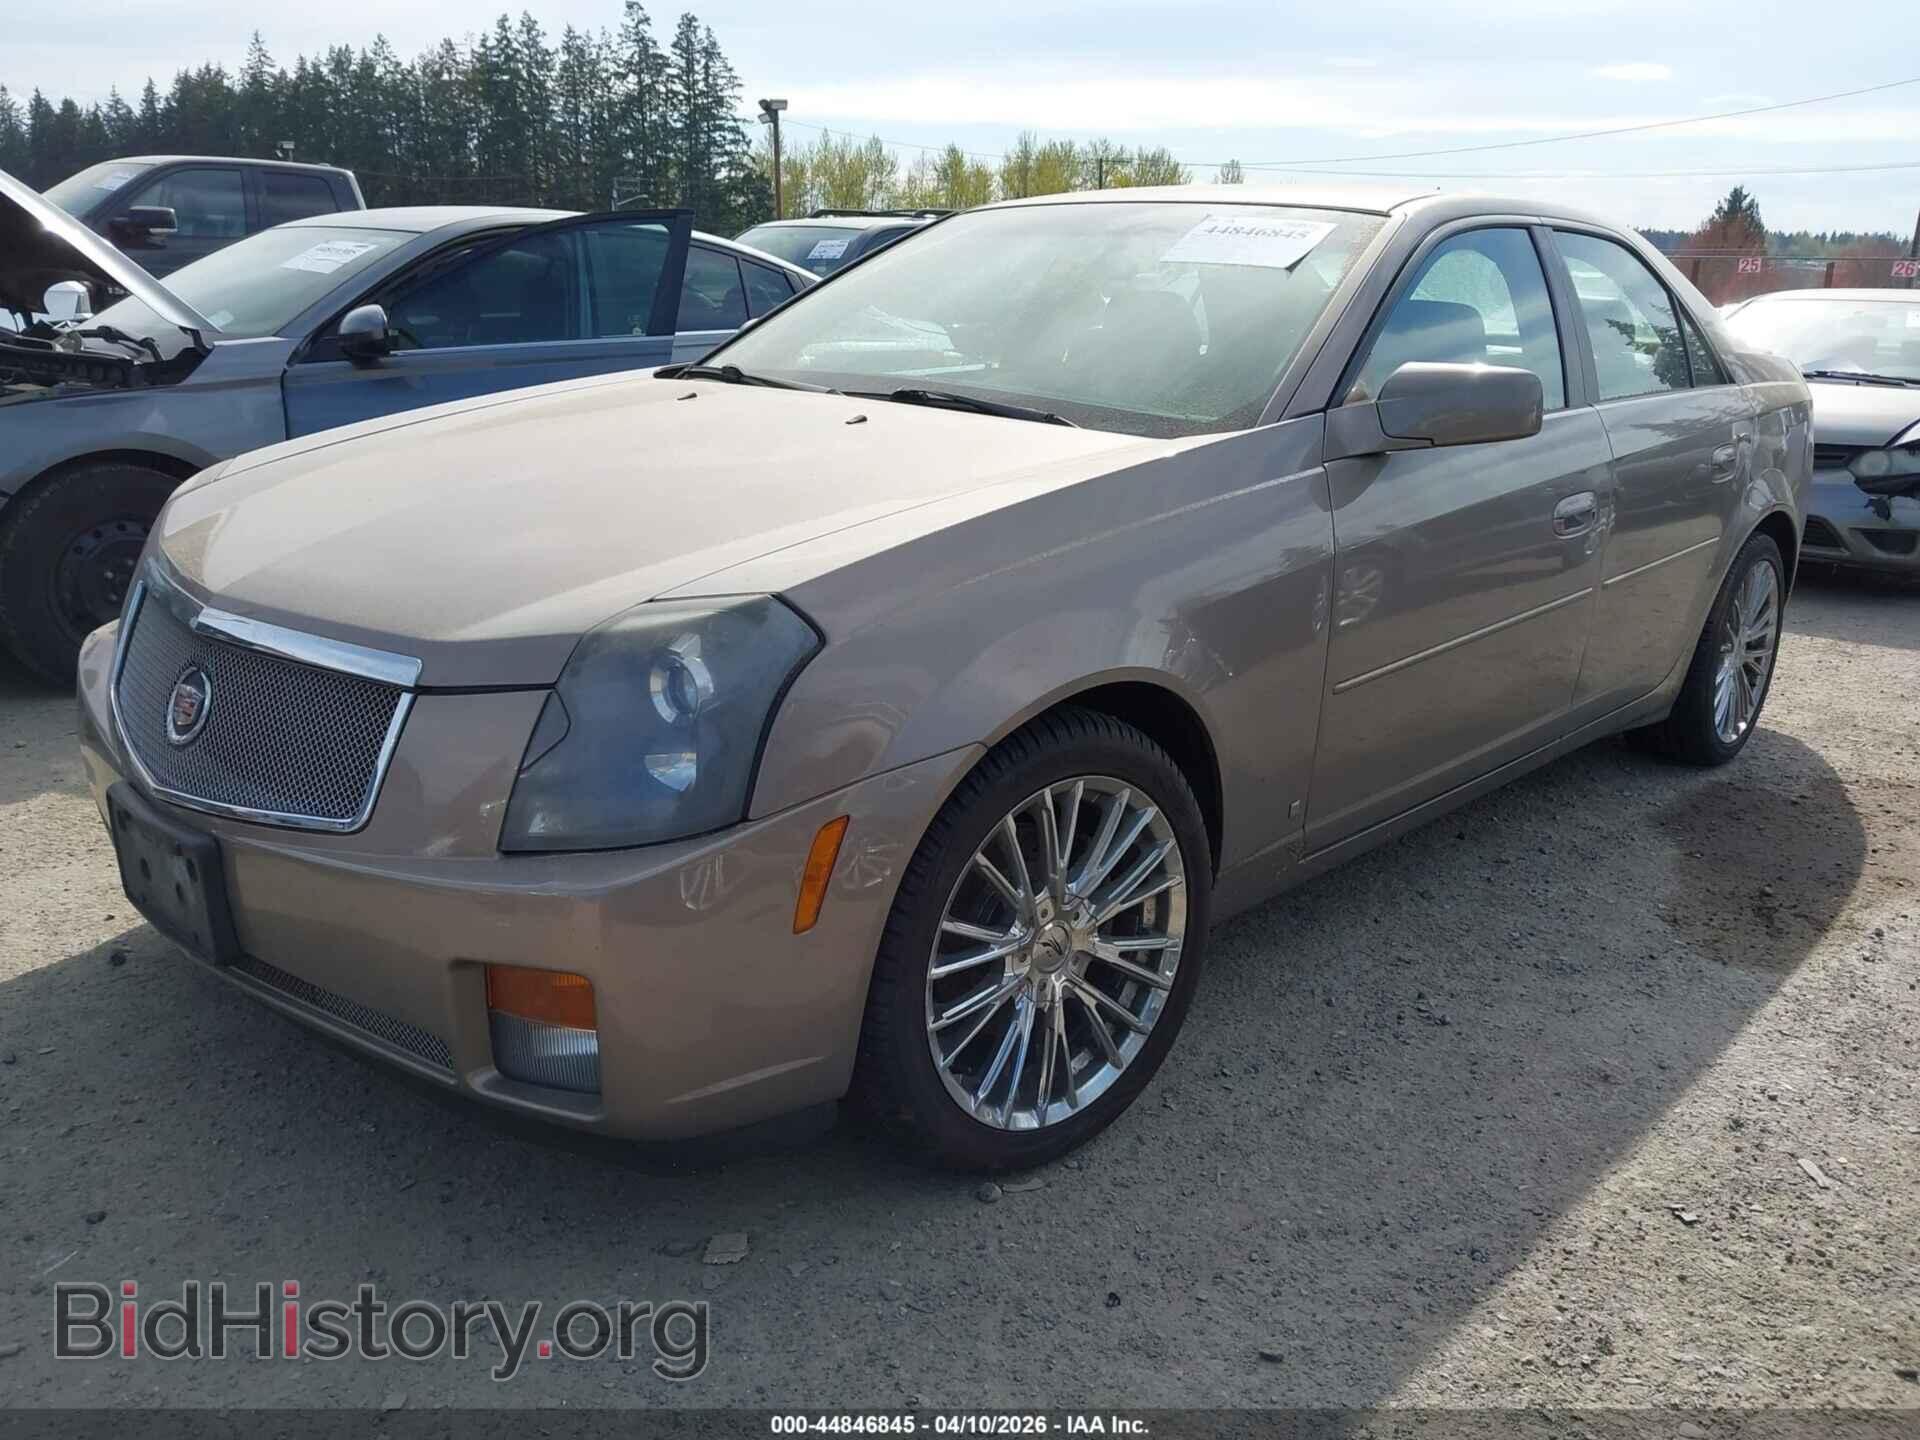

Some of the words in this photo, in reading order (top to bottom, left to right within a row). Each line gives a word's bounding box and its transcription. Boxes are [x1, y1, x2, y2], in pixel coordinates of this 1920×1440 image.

[1203, 224, 1311, 239] 44846845
[1740, 258, 1759, 272] 25
[1894, 262, 1915, 276] 26
